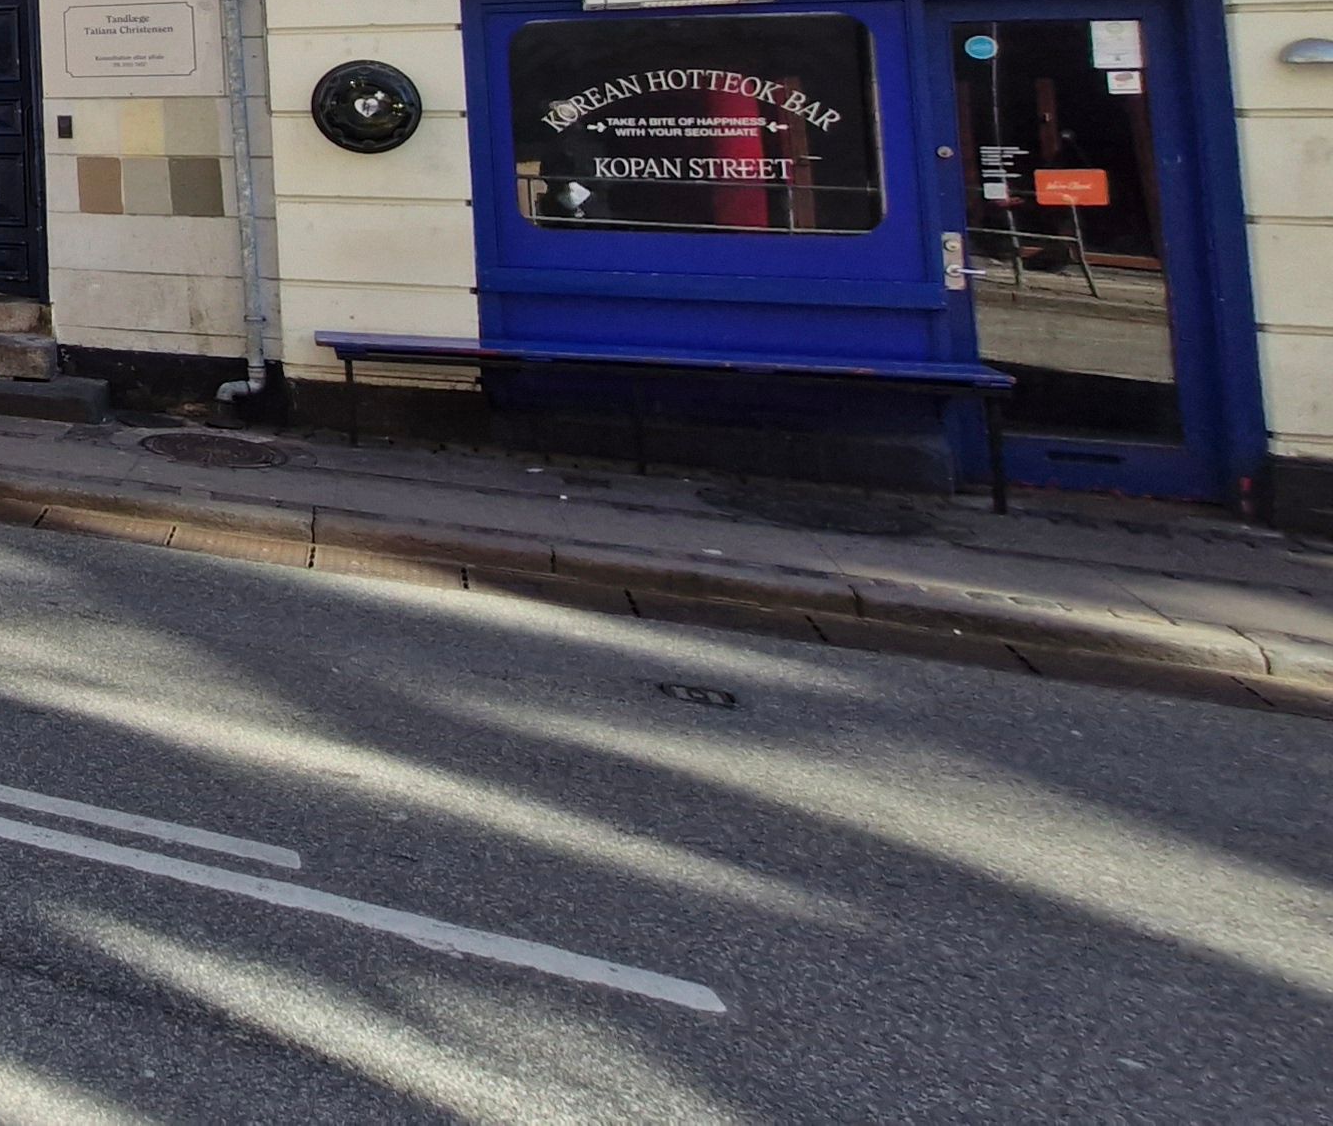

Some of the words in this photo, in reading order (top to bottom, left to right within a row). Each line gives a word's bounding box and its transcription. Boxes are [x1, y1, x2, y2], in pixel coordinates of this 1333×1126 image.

[119, 24, 174, 35] Christensen
[541, 74, 642, 133] KOREAN
[646, 69, 783, 105] HOTTEOK
[781, 90, 841, 132] BAR
[605, 117, 636, 126] TAKE
[637, 117, 647, 126] A
[649, 117, 676, 126] BITE
[678, 117, 696, 126] OF
[697, 116, 767, 126] HAPPINESS
[615, 127, 645, 137] WITH
[647, 127, 682, 137] YOUR
[684, 127, 759, 137] SEOULMATE
[594, 157, 683, 179] KOPAN
[688, 157, 793, 180] STREET
